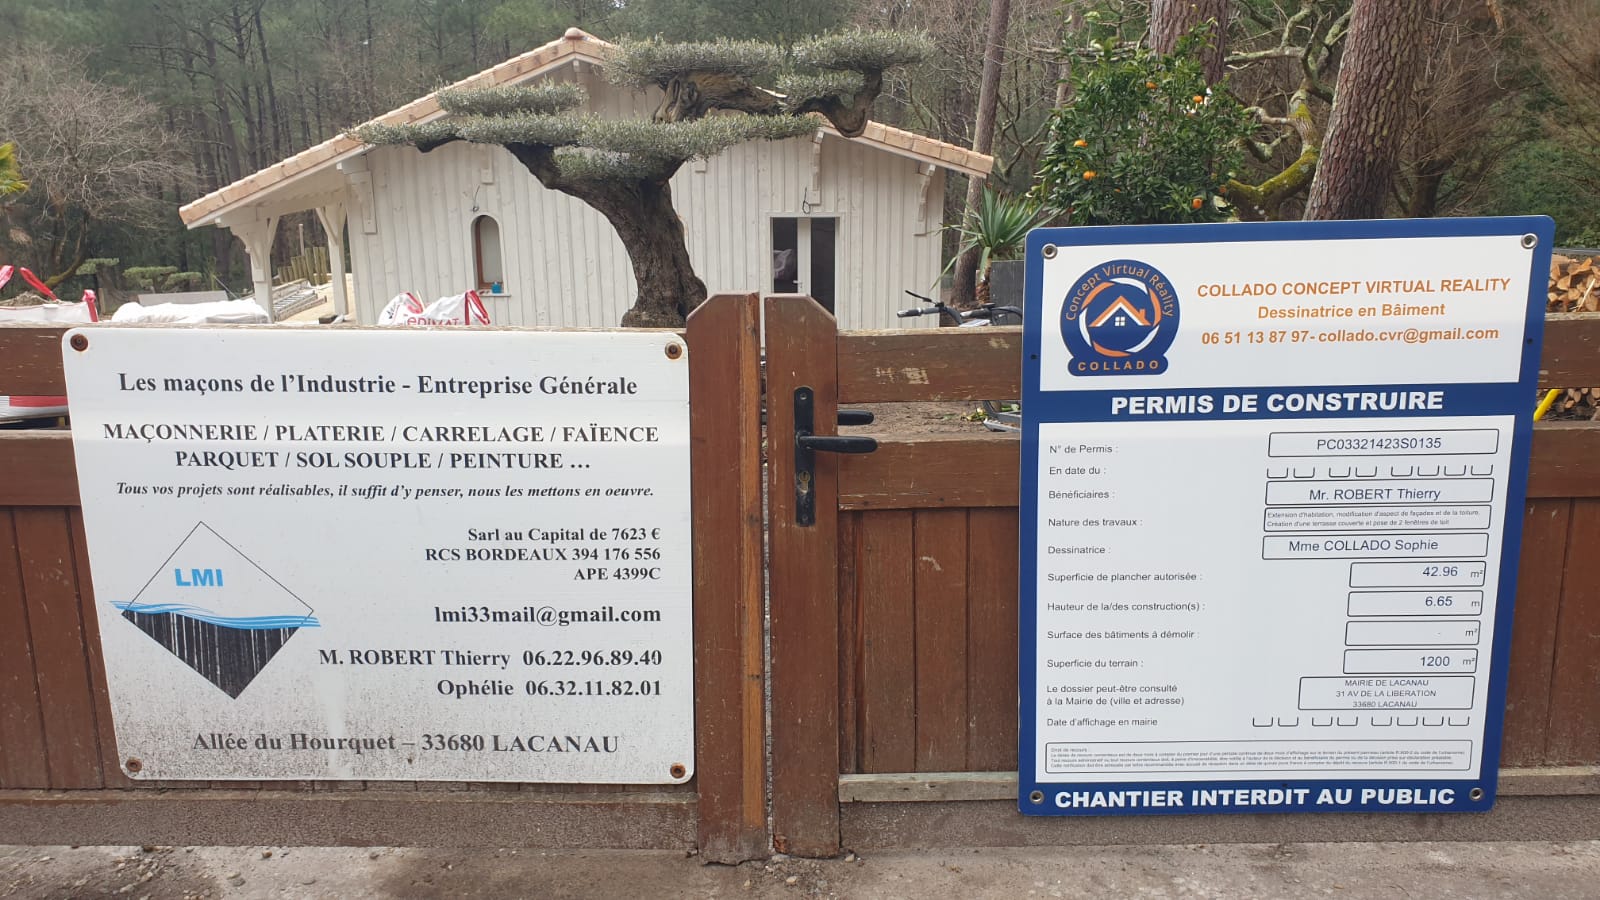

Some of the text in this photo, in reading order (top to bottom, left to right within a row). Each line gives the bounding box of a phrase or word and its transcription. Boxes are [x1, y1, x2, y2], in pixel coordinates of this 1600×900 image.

[1066, 264, 1174, 320] Concept Virtual Réality
[1198, 278, 1510, 297] COLLADO CONCEPT VIRTUAL REALITY
[1258, 304, 1445, 319] Dessinatrice en Bâiment
[1202, 332, 1219, 344] 06
[1225, 332, 1240, 344] 51
[1248, 331, 1264, 343] 13
[1269, 331, 1286, 343] 87
[1319, 328, 1499, 343] collado.cvr@gmail.com
[1078, 360, 1159, 371] COLLADO
[118, 373, 156, 391] Les
[164, 379, 243, 395] maçons
[251, 375, 274, 392] de
[418, 376, 532, 398] Entreprise
[540, 376, 637, 394] Générale
[1112, 391, 1444, 414] PERMIS DE CONSTRUIRE
[103, 423, 658, 443] MAÇONNERIE PLATERIE CARRELAGE FAÏENCE
[1050, 444, 1112, 454] N° de Permis
[1317, 438, 1441, 450] PC03321423S0135
[176, 451, 563, 470] PARQUET SOL SOUPLE PEINTURE
[1050, 465, 1100, 475] En date du
[117, 482, 148, 494] Tous
[153, 485, 173, 494] vos
[177, 483, 222, 498] projets
[227, 486, 255, 495] sont
[259, 484, 333, 497] réalisables,
[339, 485, 348, 496] il
[352, 485, 387, 499] suffit
[415, 489, 463, 500] penser,
[468, 488, 501, 497] nous
[505, 485, 523, 496] les
[528, 487, 580, 496] mettons
[585, 488, 600, 497] en
[605, 487, 653, 496] oeuvre.
[1048, 489, 1110, 499] Bénéficiaires
[1309, 488, 1441, 502] Mr. ROBERT Thierry
[1049, 518, 1137, 527] Nature des travaux
[468, 528, 660, 544] Sarl au Capital de 7623 €
[1048, 545, 1105, 554] Dessinatrice
[1288, 539, 1439, 553] Mme COLLADO Sophie
[426, 548, 660, 561] RCS BORDEAUX 394 176 556
[574, 568, 660, 580] APE 4399C
[1047, 572, 1197, 583] Superficie de plancher autorisée
[1422, 566, 1459, 577] 42.96
[175, 569, 223, 587] LMI
[1048, 602, 1199, 611] Hauteur de la/des construction(s)
[1425, 596, 1480, 608] 6.65 m
[435, 606, 661, 626] lmi33mail@gmail.com
[1047, 630, 1195, 639] Surface des bâtiments à démolir
[319, 650, 662, 670] M. ROBERT Thierry 06.22.96.89.40
[1047, 658, 1138, 669] Superficie du terrain
[1420, 656, 1451, 667] 1200
[1047, 684, 1177, 694] Le dossier peut-être consulté
[1345, 679, 1428, 687] MAIRIE DE LACANAU
[438, 680, 660, 699] Ophélie 06.32.11.82.01
[1336, 690, 1344, 698] 31
[1361, 690, 1371, 698] DE
[1375, 690, 1384, 698] LA
[1387, 689, 1436, 697] LIBERATION
[1047, 696, 1184, 706] à la Mairie de (ville et adresse)
[1352, 699, 1418, 709] 33680 LACANAU
[1047, 718, 1067, 727] Date
[193, 732, 619, 756] Allée du Hourquet 33680 LACANAU
[1055, 789, 1454, 808] CHANTIER INTERDIT AU PUBLIC
